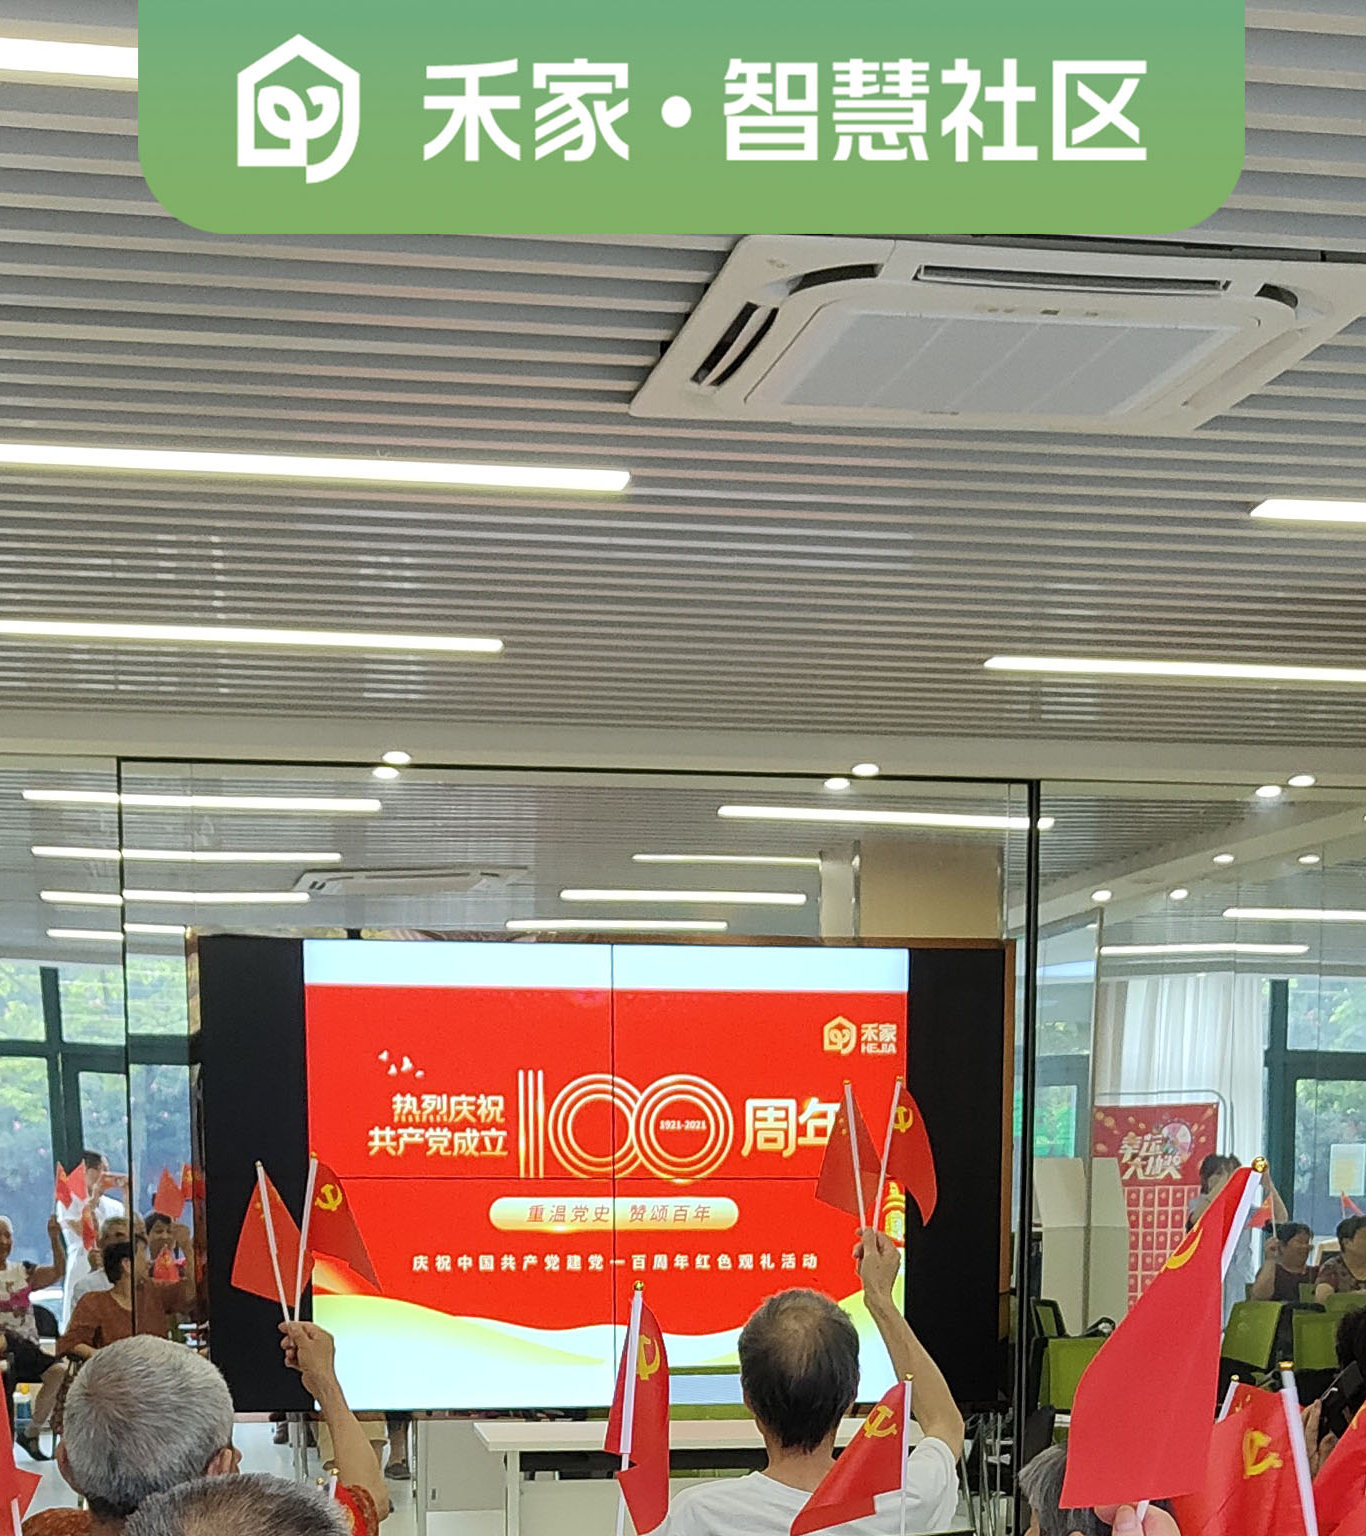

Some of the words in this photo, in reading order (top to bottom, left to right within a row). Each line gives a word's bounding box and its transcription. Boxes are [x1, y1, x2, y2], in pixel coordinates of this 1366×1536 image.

[860, 1022, 898, 1043] 禾家
[860, 1042, 898, 1055] HEJIA
[391, 1093, 507, 1124] 热烈庆祝
[659, 1118, 708, 1131] 1921-2021
[367, 1126, 509, 1158] 共产党成立
[526, 1204, 612, 1225] 重温党史
[627, 1203, 712, 1224] 赞颂百年
[411, 1253, 819, 1273] 庆祝中国共产党建党一百周年红色观礼活动
